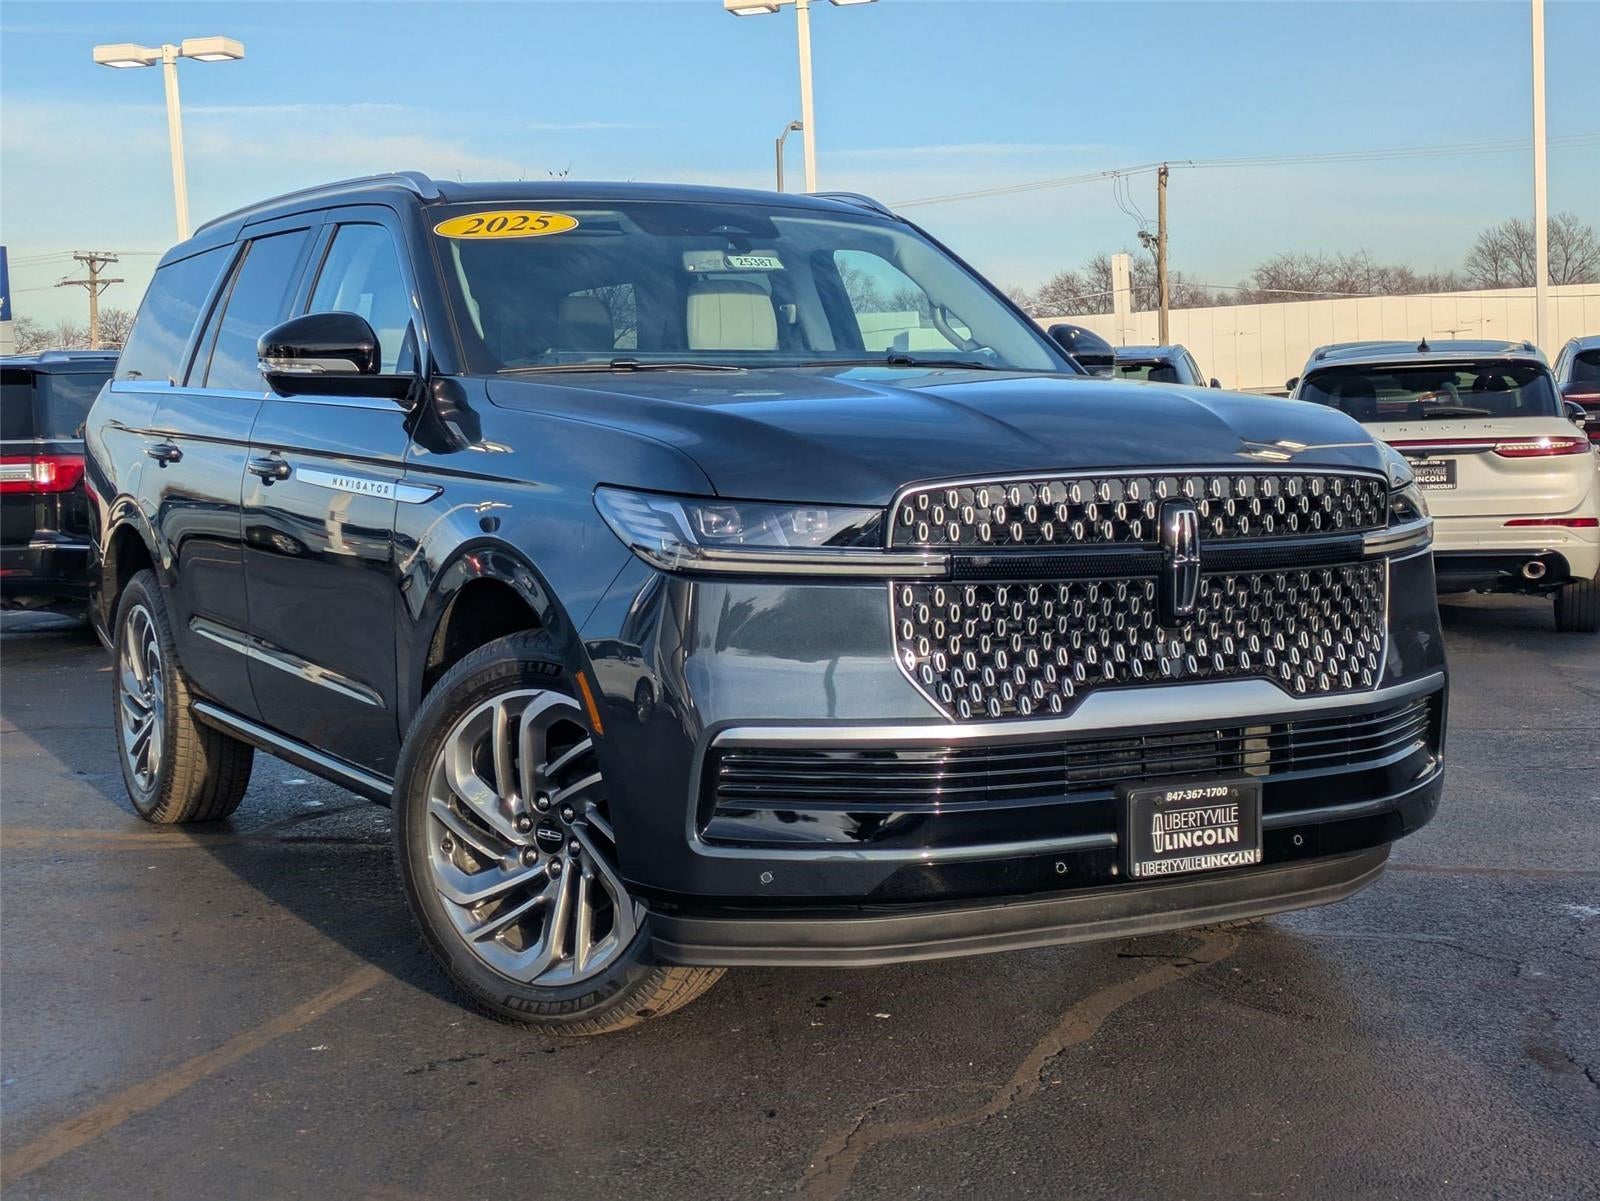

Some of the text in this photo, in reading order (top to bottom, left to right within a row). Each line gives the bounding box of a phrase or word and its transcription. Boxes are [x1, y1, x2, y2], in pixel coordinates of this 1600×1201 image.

[461, 215, 553, 235] 2025
[735, 257, 773, 267] 25387
[332, 477, 389, 494] NAVIGATOR
[1166, 786, 1228, 801] 847-367-1700
[1164, 806, 1239, 830] LIBERTYVILLE
[1165, 826, 1239, 850] LINCOLN
